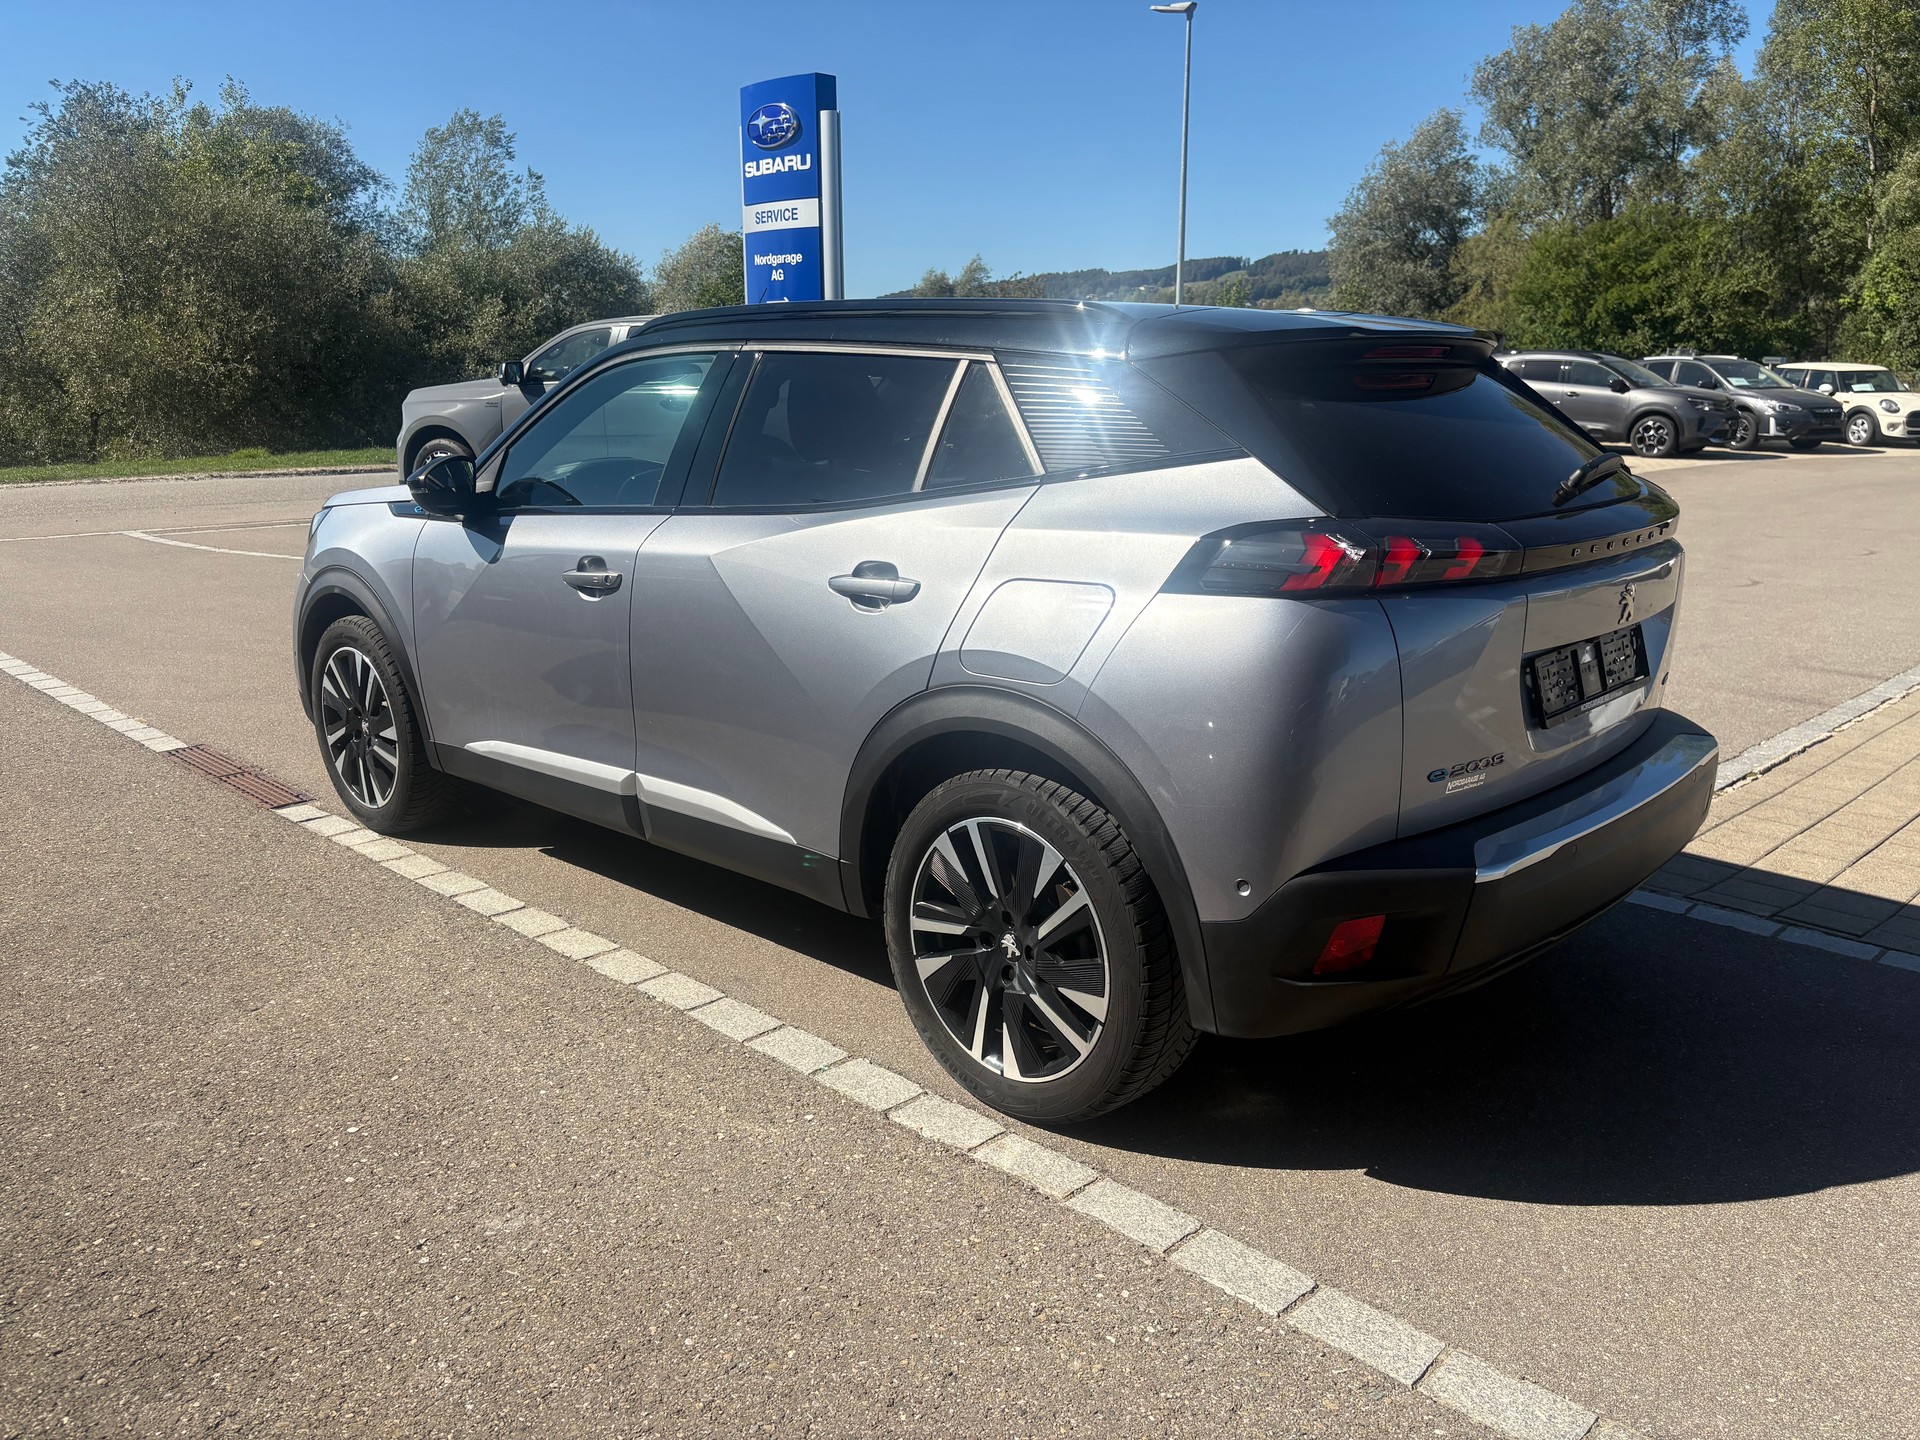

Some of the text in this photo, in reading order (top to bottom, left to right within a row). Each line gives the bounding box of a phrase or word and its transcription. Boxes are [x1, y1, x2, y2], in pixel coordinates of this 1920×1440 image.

[745, 153, 811, 178] SUBARU
[755, 207, 799, 225] SERVICE
[754, 252, 803, 267] Nordgarage
[771, 269, 785, 281] AG
[1571, 526, 1666, 557] PEUGEOT
